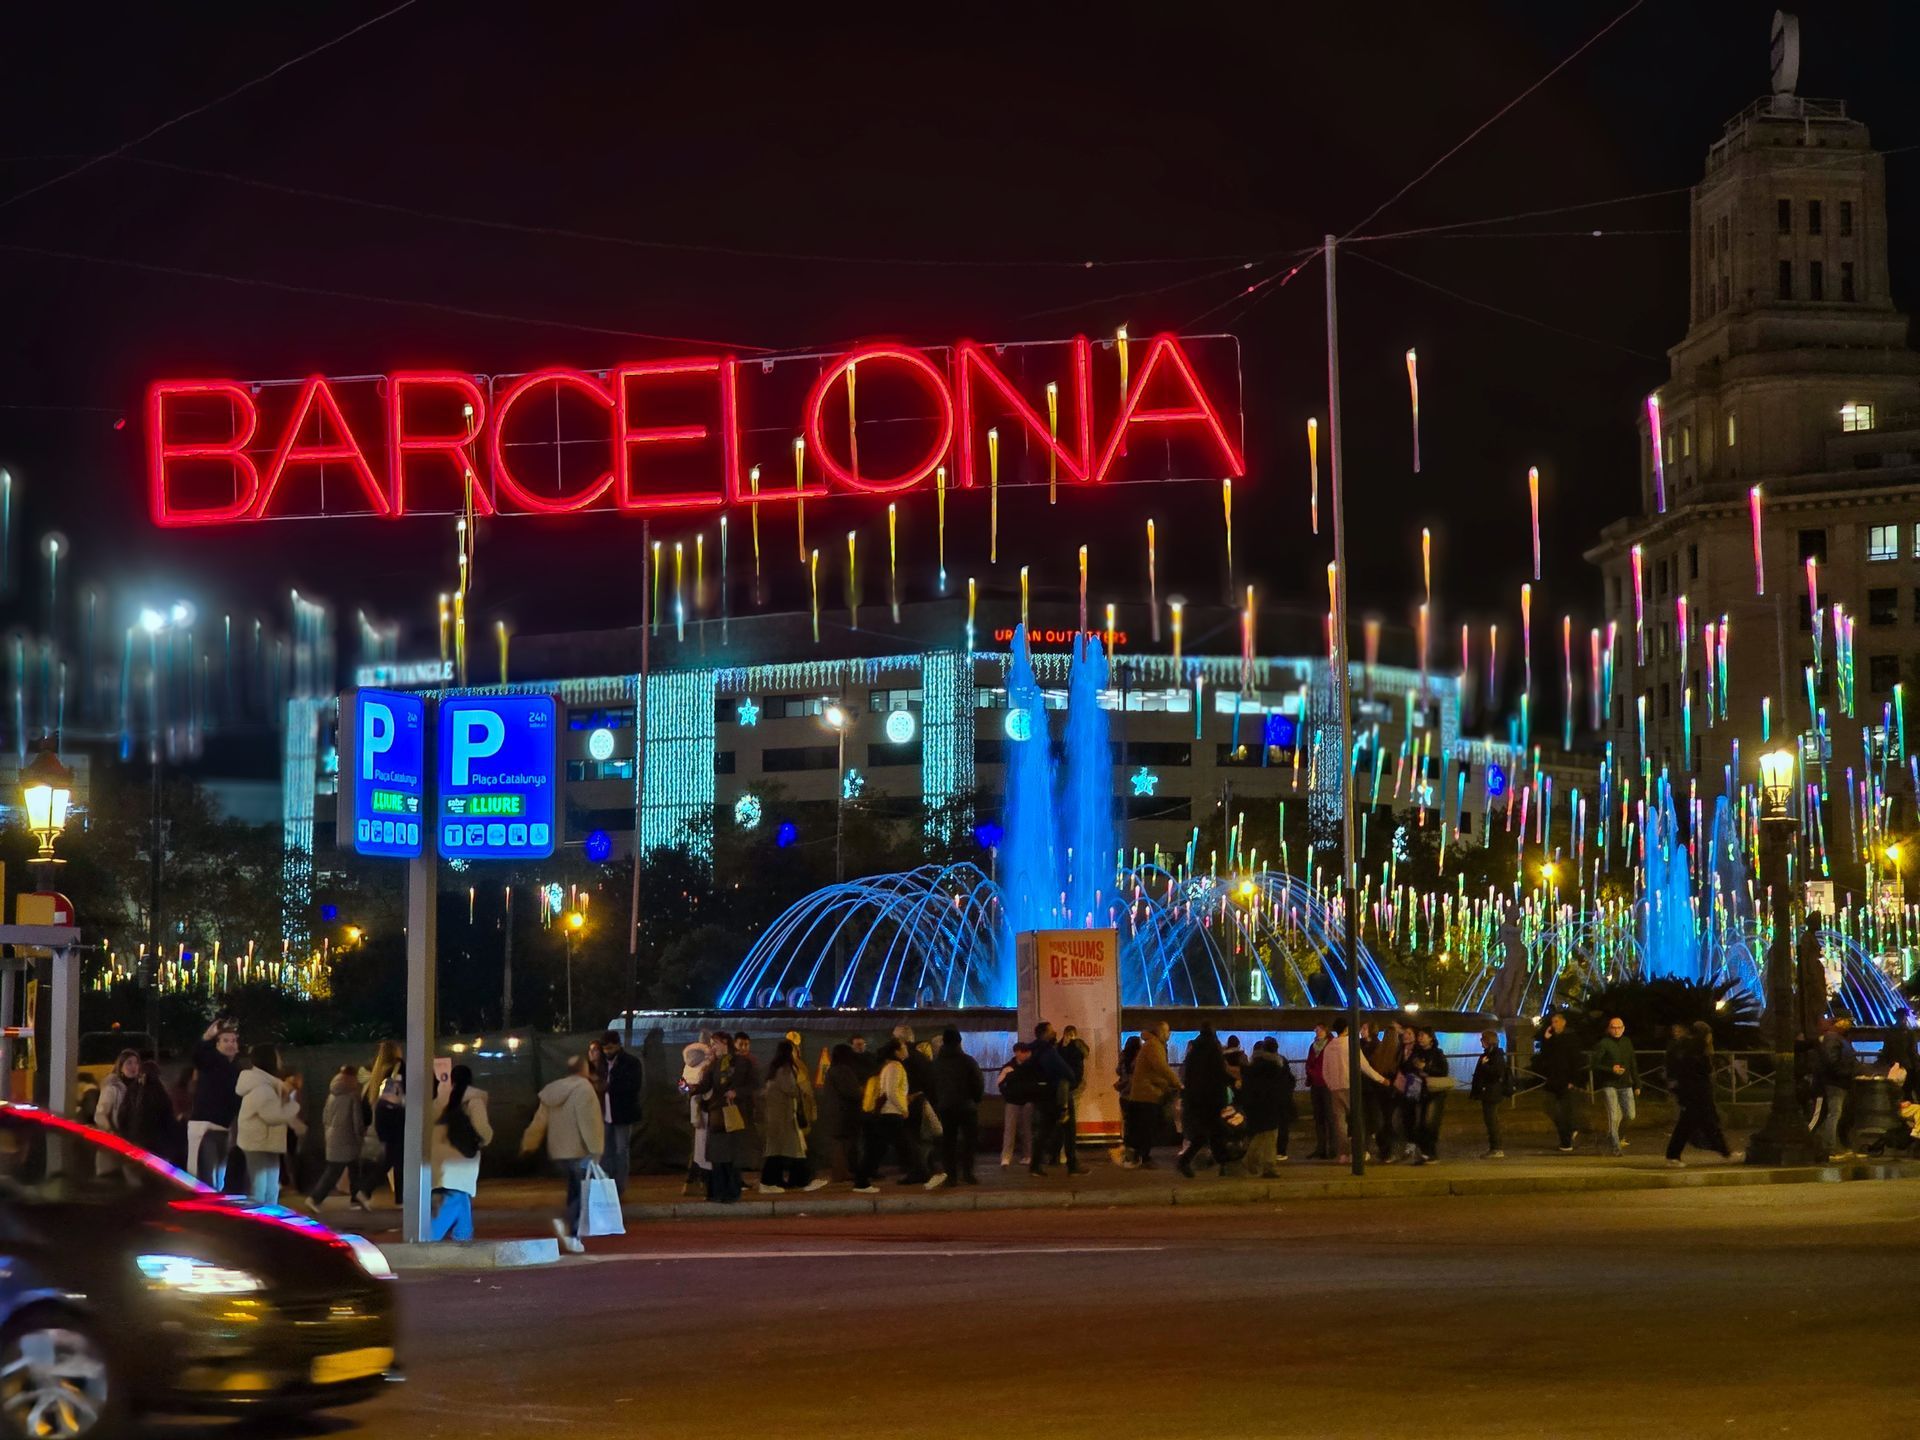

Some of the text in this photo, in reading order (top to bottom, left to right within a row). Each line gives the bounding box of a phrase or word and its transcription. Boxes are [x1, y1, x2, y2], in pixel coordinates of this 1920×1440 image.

[152, 332, 1246, 527] BARCELONA
[994, 629, 1041, 642] URN
[529, 712, 547, 722] 24h
[363, 701, 395, 780] P
[452, 709, 505, 786] P
[472, 773, 547, 788] Plaça Catalunya
[472, 797, 520, 813] LLIURE
[1051, 955, 1068, 978] DE
